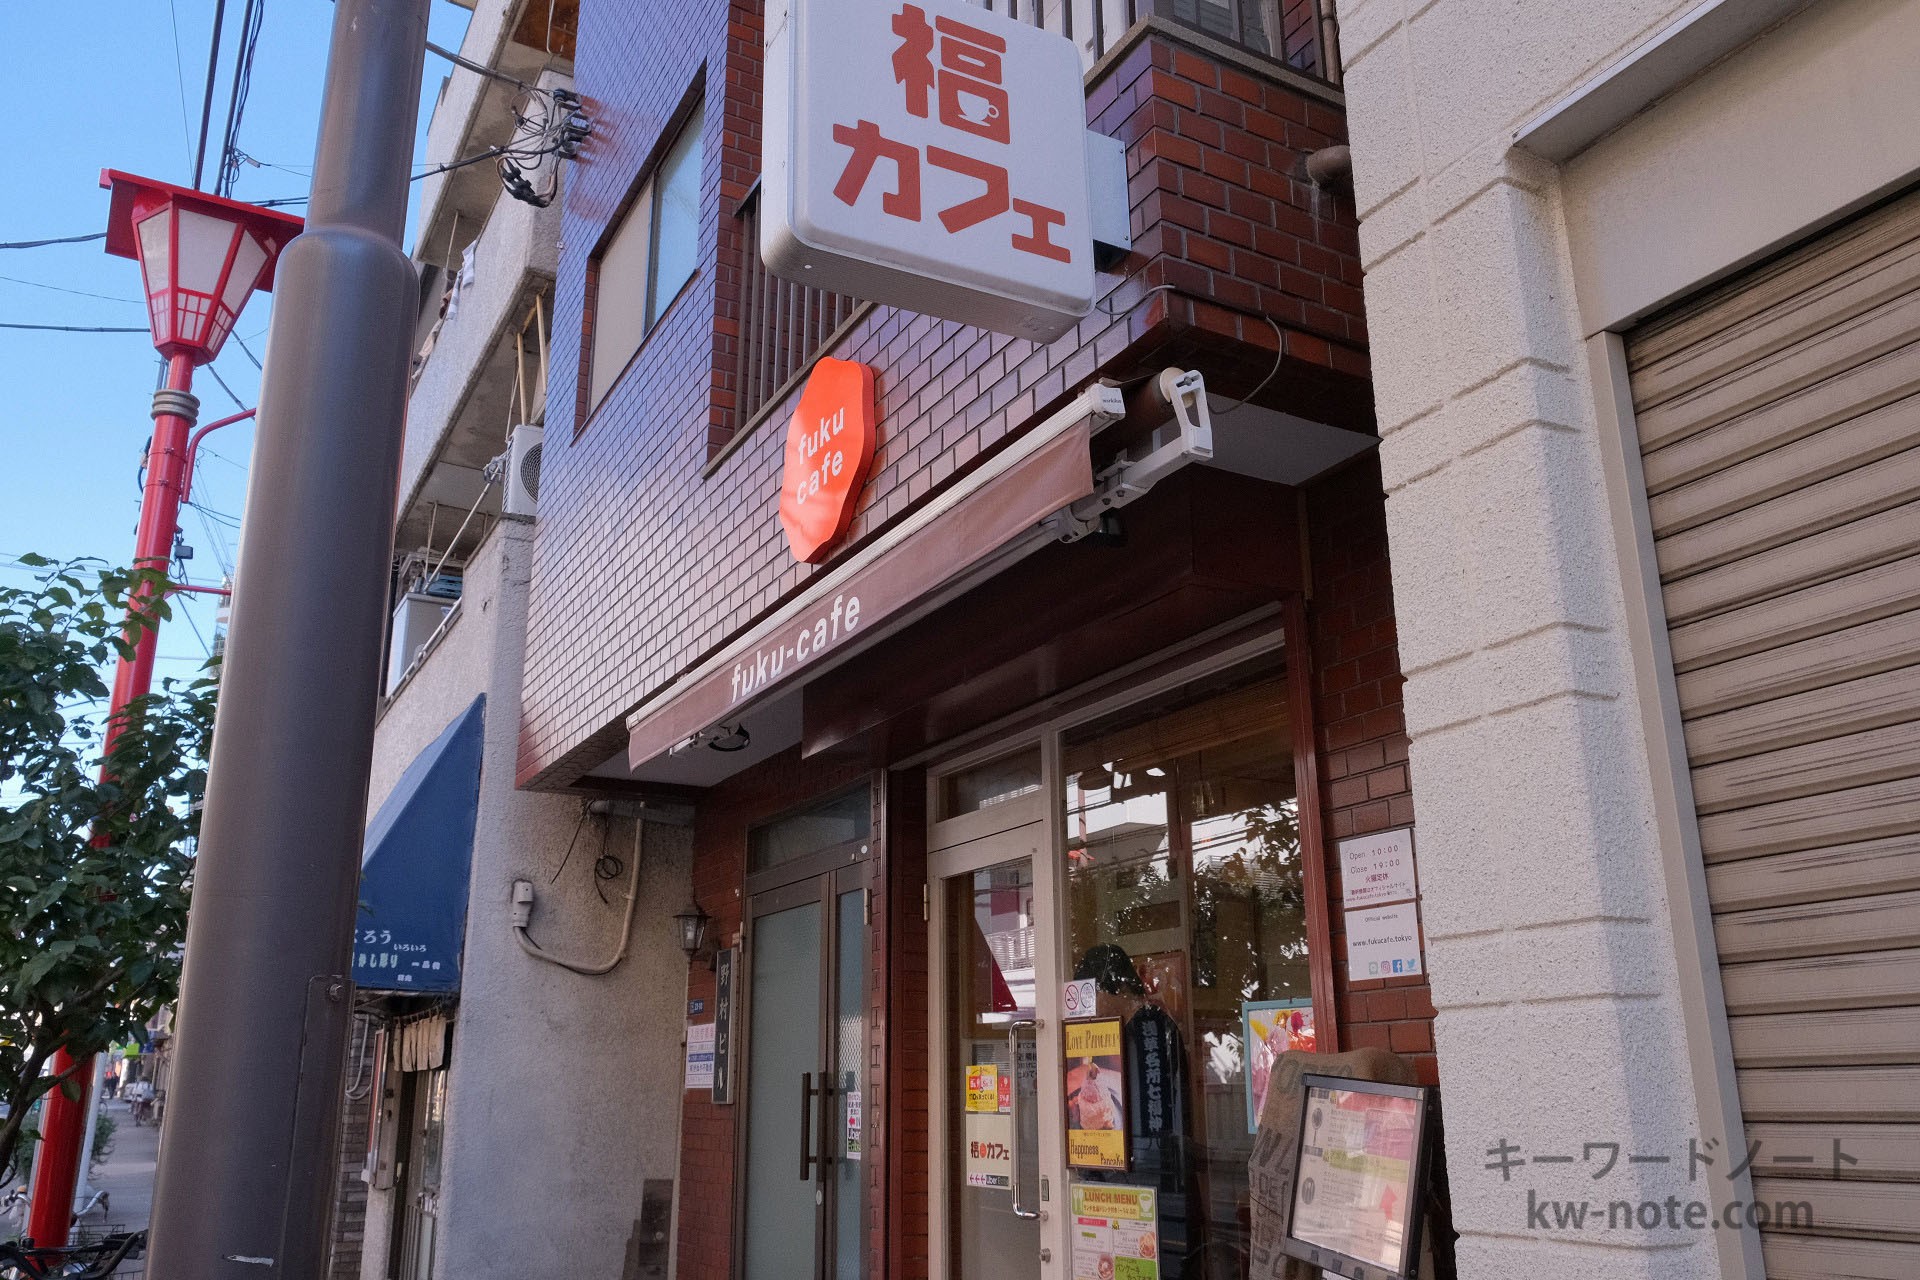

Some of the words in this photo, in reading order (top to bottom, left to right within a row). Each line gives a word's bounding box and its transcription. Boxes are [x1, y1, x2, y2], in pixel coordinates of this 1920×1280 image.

[892, 3, 1010, 145] 福
[833, 119, 1071, 264] カフェ
[797, 407, 844, 466] fuku
[796, 449, 843, 505] cafe
[730, 594, 861, 702] fuku-cafe
[1349, 851, 1366, 861] Open
[1371, 844, 1399, 857] 10:00
[1350, 865, 1368, 875] Close
[393, 943, 427, 953] いろいろ
[1352, 934, 1412, 947] www.fukucafe.tokyo
[718, 962, 730, 1090] 野村ビル
[1070, 1138, 1099, 1159] Happiness
[986, 1175, 997, 1185] Uber
[1084, 1192, 1112, 1203] LUNCH
[1113, 1193, 1138, 1205] MENU
